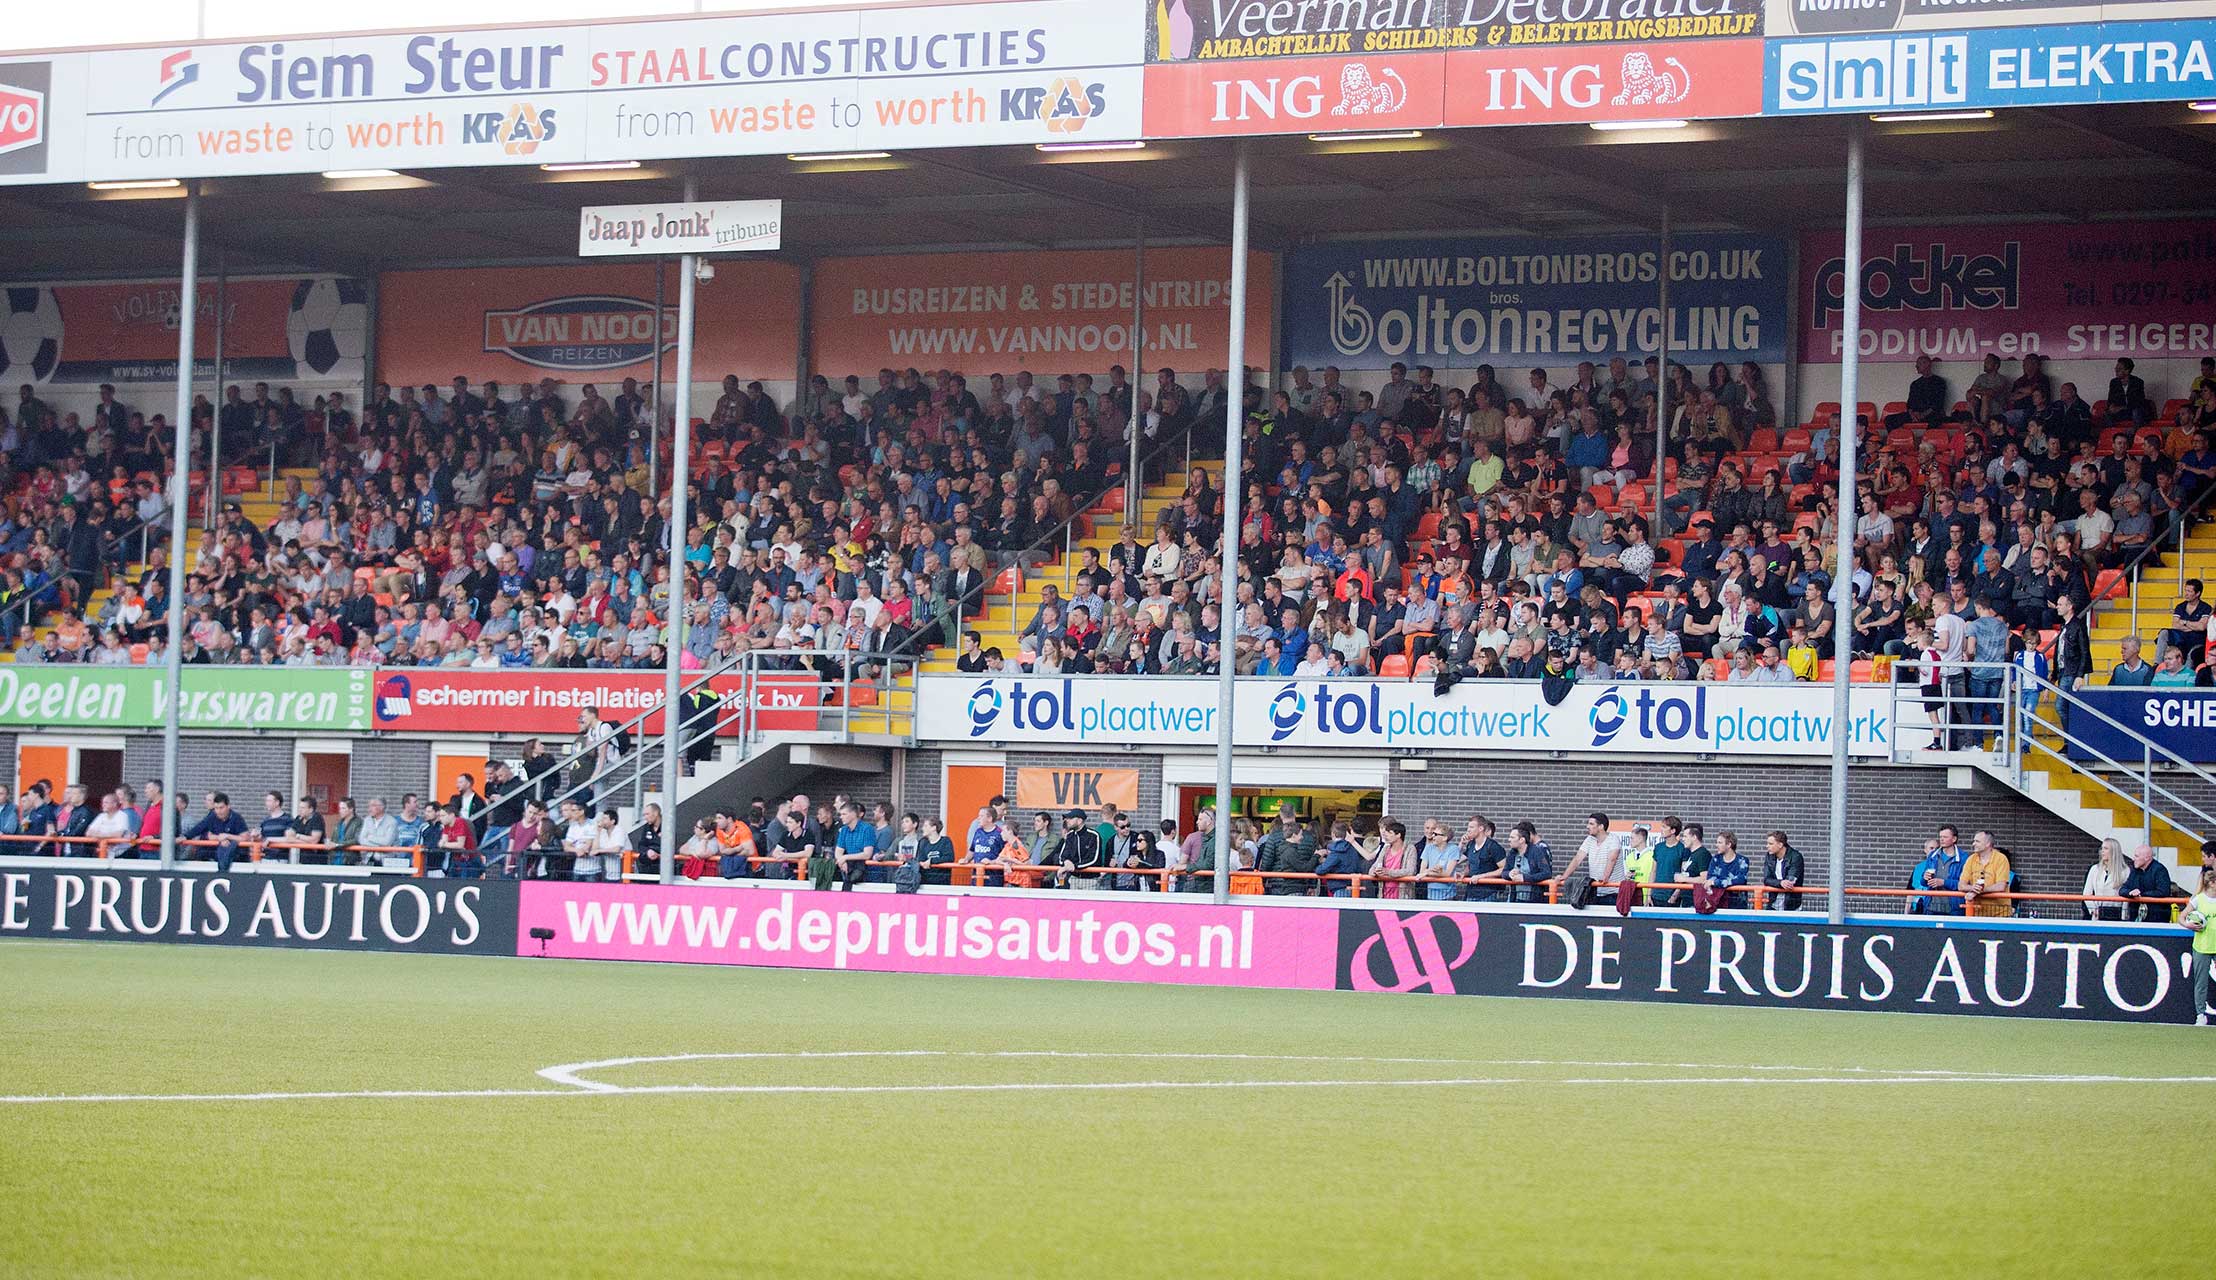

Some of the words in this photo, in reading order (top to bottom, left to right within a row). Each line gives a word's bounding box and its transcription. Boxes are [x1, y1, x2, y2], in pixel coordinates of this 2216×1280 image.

[1199, 33, 1352, 59] AMBACHTELIJK
[1363, 27, 1477, 51] SCHILDERS
[1487, 24, 1506, 46] &
[1509, 13, 1757, 44] BELETTERINGSBEDRIJF
[1210, 0, 1433, 38] Veerman
[236, 43, 374, 102] Siem
[404, 35, 563, 94] Steur
[590, 28, 1046, 87] STAALCONSTRUCTIES
[1485, 64, 1604, 111] ING
[1786, 43, 1960, 102] smit
[1988, 40, 2215, 89] ELEKTRA
[616, 104, 695, 138] from
[709, 98, 816, 134] waste
[830, 97, 861, 128] to
[876, 88, 986, 128] worth
[1000, 83, 1106, 122] KRAS
[1211, 75, 1325, 122] ING
[113, 126, 184, 160] from
[198, 121, 293, 156] waste
[305, 121, 334, 151] to
[346, 112, 444, 149] worth
[463, 108, 557, 144] KRAS
[715, 220, 778, 244] tribune
[852, 285, 1007, 315] BUSREIZEN
[1018, 283, 1040, 311] &
[1489, 291, 1524, 305] bros.
[501, 314, 569, 343] VAN
[552, 345, 623, 363] REIZEN
[416, 684, 531, 706] schermer
[772, 689, 804, 708] bv
[1010, 679, 1075, 731] tol
[1080, 698, 1217, 739] plaatwer
[1314, 683, 1383, 735] tol
[1387, 702, 1551, 743] plaatwerk
[1636, 686, 1709, 740] tol
[1051, 771, 1103, 806] VIK
[51, 873, 232, 936] PRUIS
[245, 880, 481, 945] AUTO'S
[564, 891, 1254, 969] www.depruisautos.nl
[1518, 923, 1622, 990] DE
[1654, 927, 1895, 1002] PRUIS
[1922, 935, 2216, 1013] AUTO'
